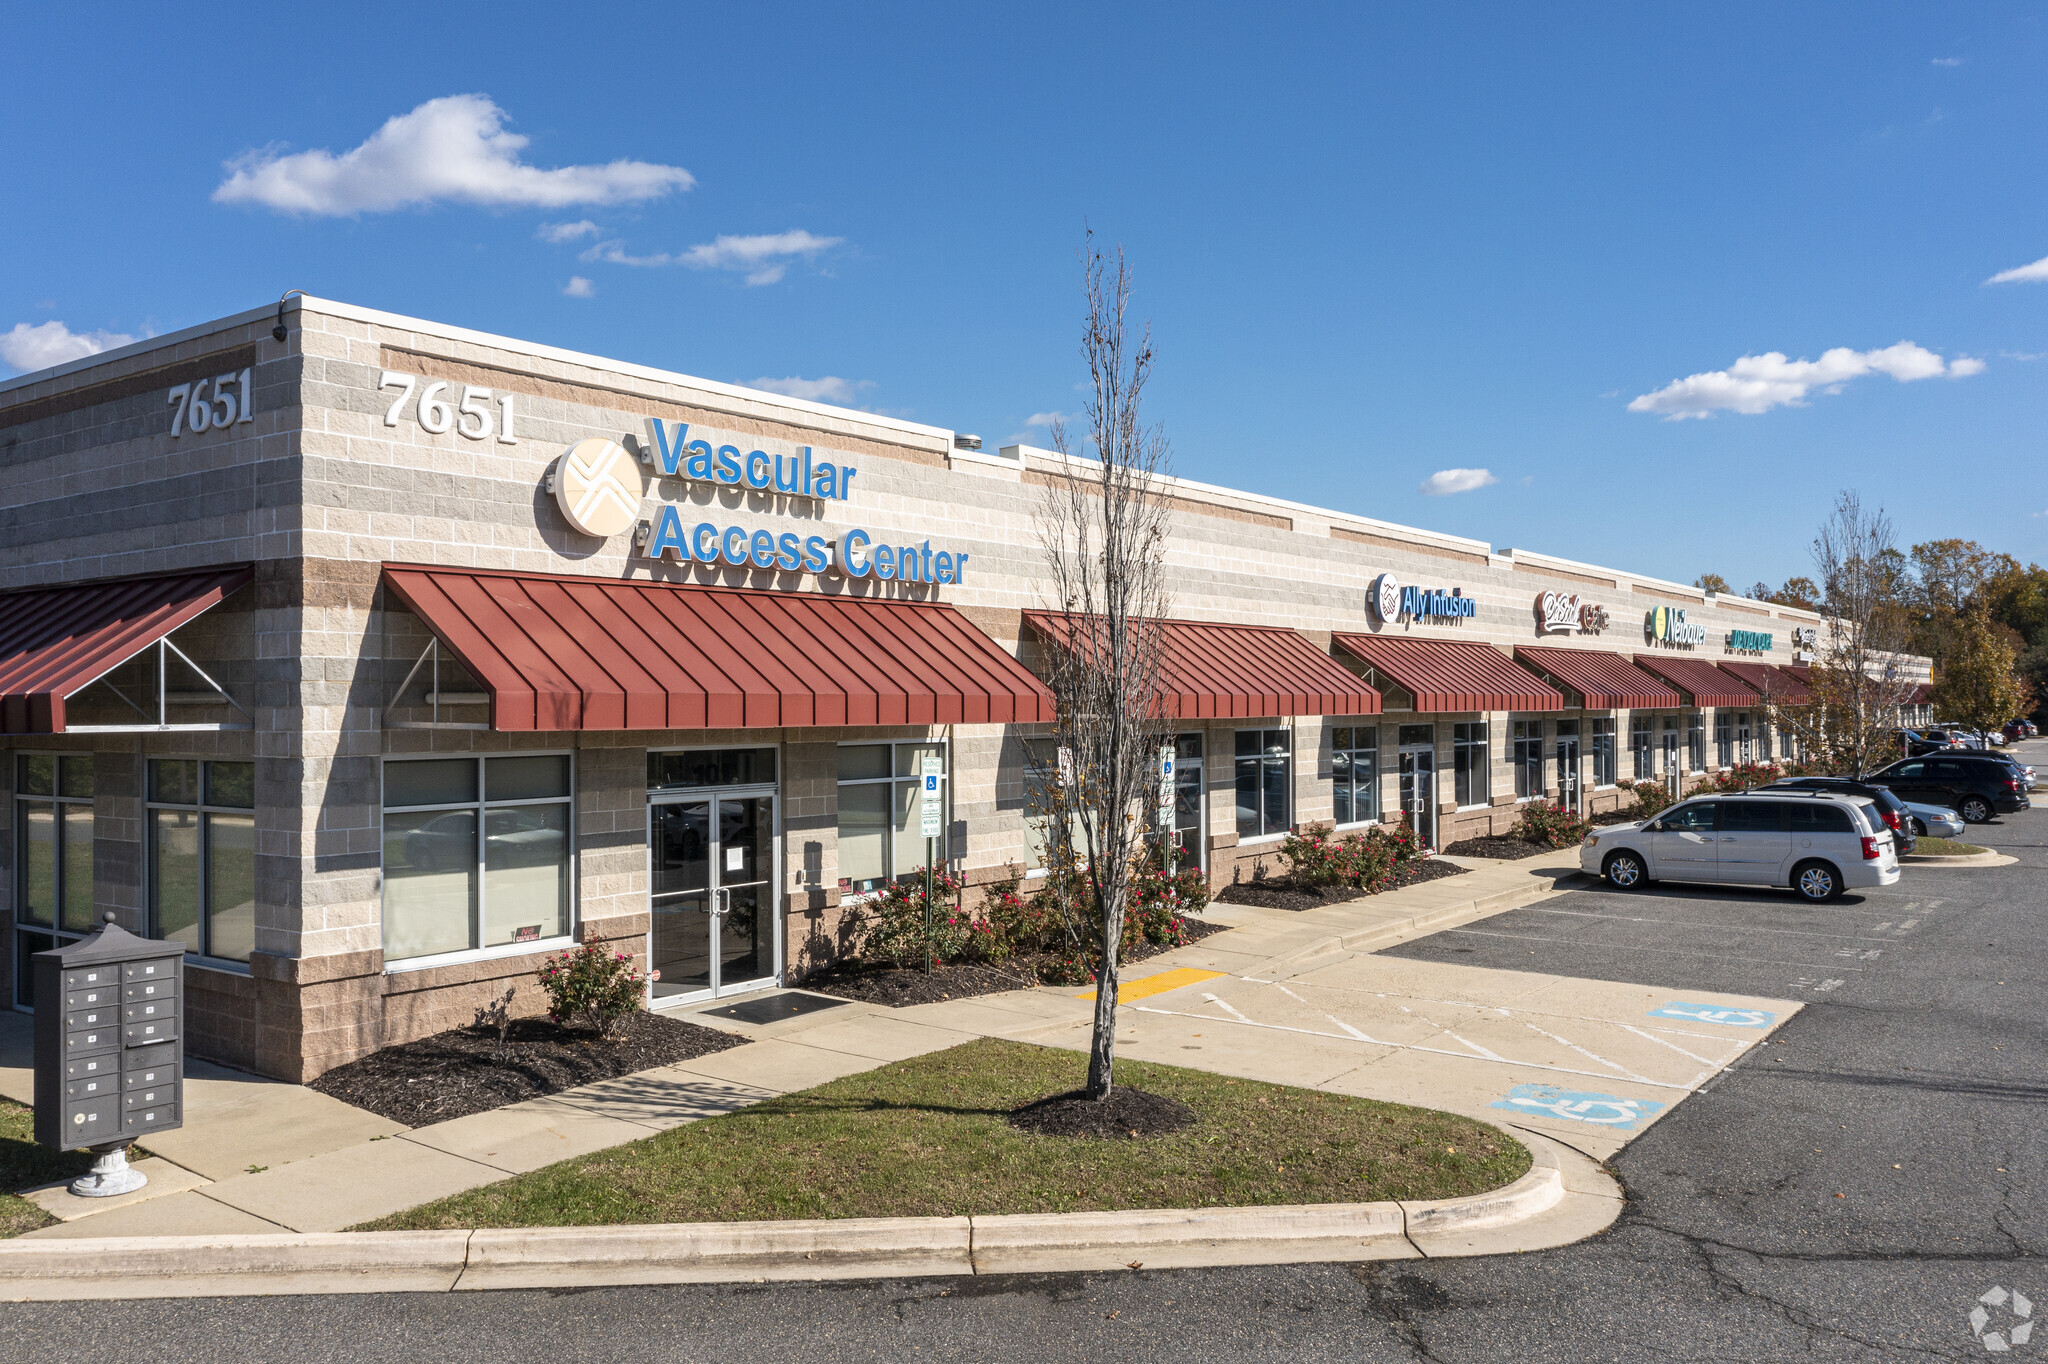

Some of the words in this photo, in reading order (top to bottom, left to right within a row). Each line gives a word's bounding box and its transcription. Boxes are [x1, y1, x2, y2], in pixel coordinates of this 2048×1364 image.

[168, 367, 254, 439] 7651
[377, 370, 518, 445] 7651
[651, 418, 857, 501] Vascular
[650, 505, 828, 574] Access
[843, 528, 969, 585] Center
[1402, 585, 1427, 622] Ally
[1430, 588, 1476, 617] Infusion
[1666, 606, 1708, 645] Neibauer
[1733, 630, 1756, 650] DENTAL
[1757, 632, 1773, 651] CARE
[521, 926, 535, 936] NO
